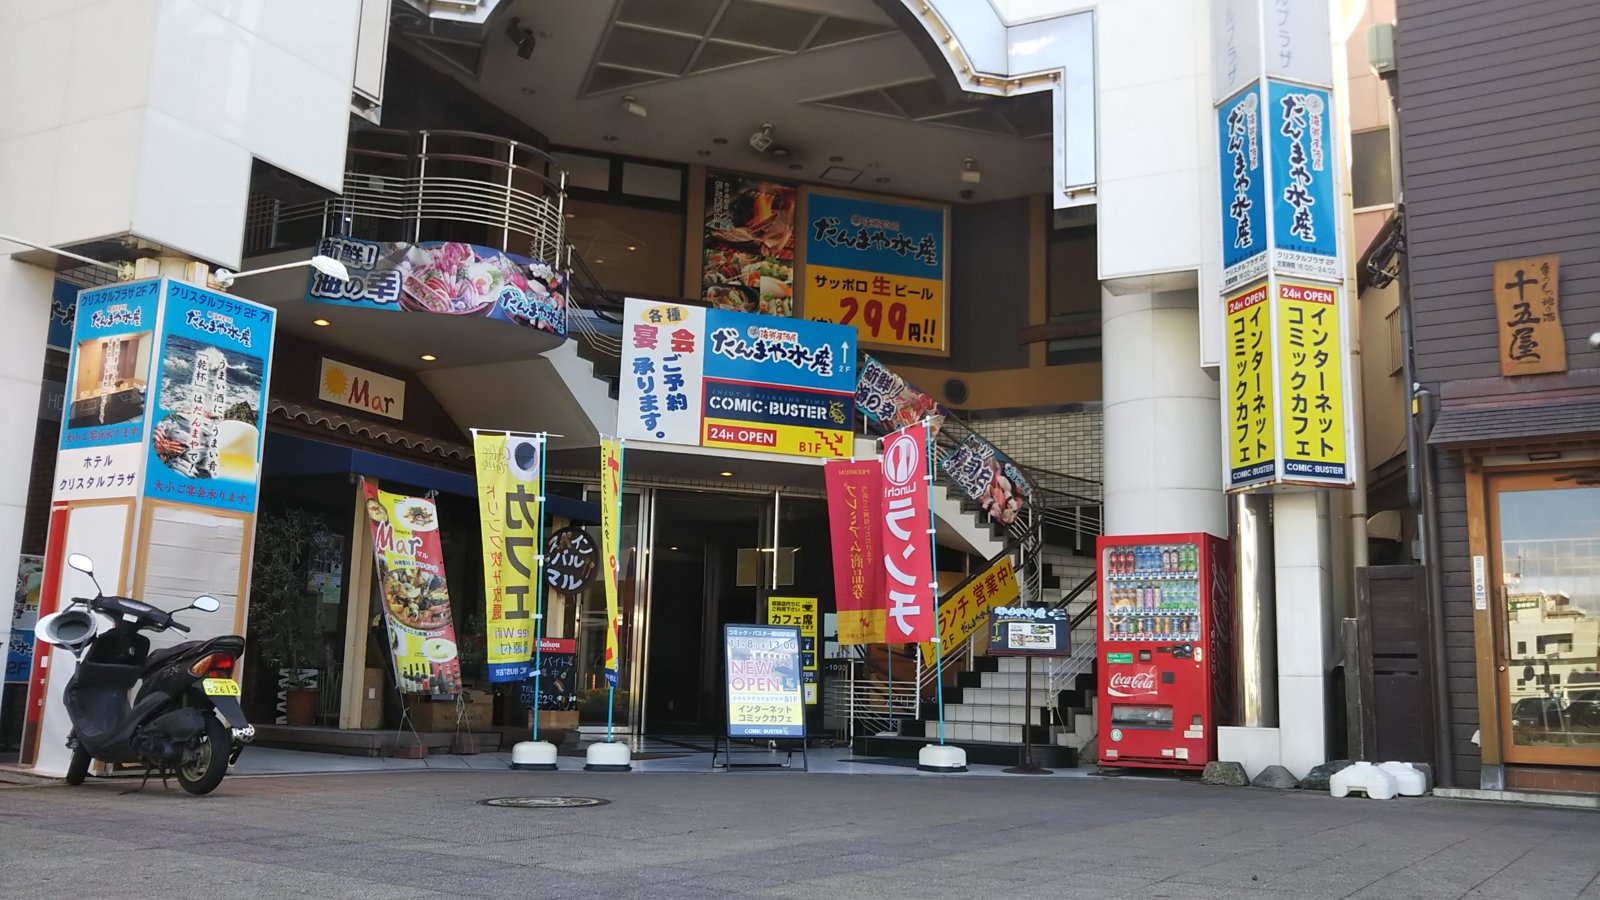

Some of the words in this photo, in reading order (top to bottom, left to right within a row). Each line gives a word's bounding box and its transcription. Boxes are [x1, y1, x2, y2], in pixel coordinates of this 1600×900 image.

[1227, 104, 1252, 249] だんまや水産
[1281, 94, 1315, 242] だんまや水産
[813, 216, 938, 265] だんまや水産
[81, 289, 134, 306] クリスタルプラザ
[136, 286, 147, 299] 2F
[171, 285, 243, 316] クリスタルプラザ
[244, 306, 257, 319] 2F
[1229, 300, 1244, 314] 24H
[1244, 290, 1266, 308] OPEN
[1282, 287, 1301, 300] 24H
[1304, 290, 1332, 304] OPEN
[91, 306, 142, 329] だんまや水産
[186, 309, 252, 348] だんまや水産
[648, 306, 682, 324] 各種
[1505, 270, 1541, 361] 十五屋
[711, 327, 833, 377] だんまや水産
[838, 365, 851, 373] 2F
[348, 377, 395, 414] Mar
[662, 355, 688, 412] ご予約
[1234, 317, 1250, 463] コミックカフェ
[1250, 307, 1267, 459] インターネット
[1288, 307, 1311, 457] コミックカフェ
[1311, 307, 1334, 458] インターネット
[632, 357, 665, 439] 承ります。
[856, 380, 897, 421] 海の幸
[710, 428, 734, 441] 24H
[738, 430, 775, 445] OPEN
[799, 442, 822, 454] B1F
[84, 455, 114, 469] ホテル
[59, 472, 136, 490] クリスタルプラザ
[154, 480, 251, 507] 大小ご宴会承ります。
[374, 522, 423, 557] Mar
[551, 552, 585, 568] バル
[546, 568, 584, 590] マル
[972, 562, 1014, 608] 営業中!
[772, 614, 813, 625] カフェ席
[942, 633, 955, 651] 2F
[731, 660, 772, 675] NEW
[1110, 671, 1156, 689] Coca-Cola
[731, 677, 780, 692] OPEN
[738, 705, 792, 714] インターネット
[738, 715, 793, 723] コミックカフェ
